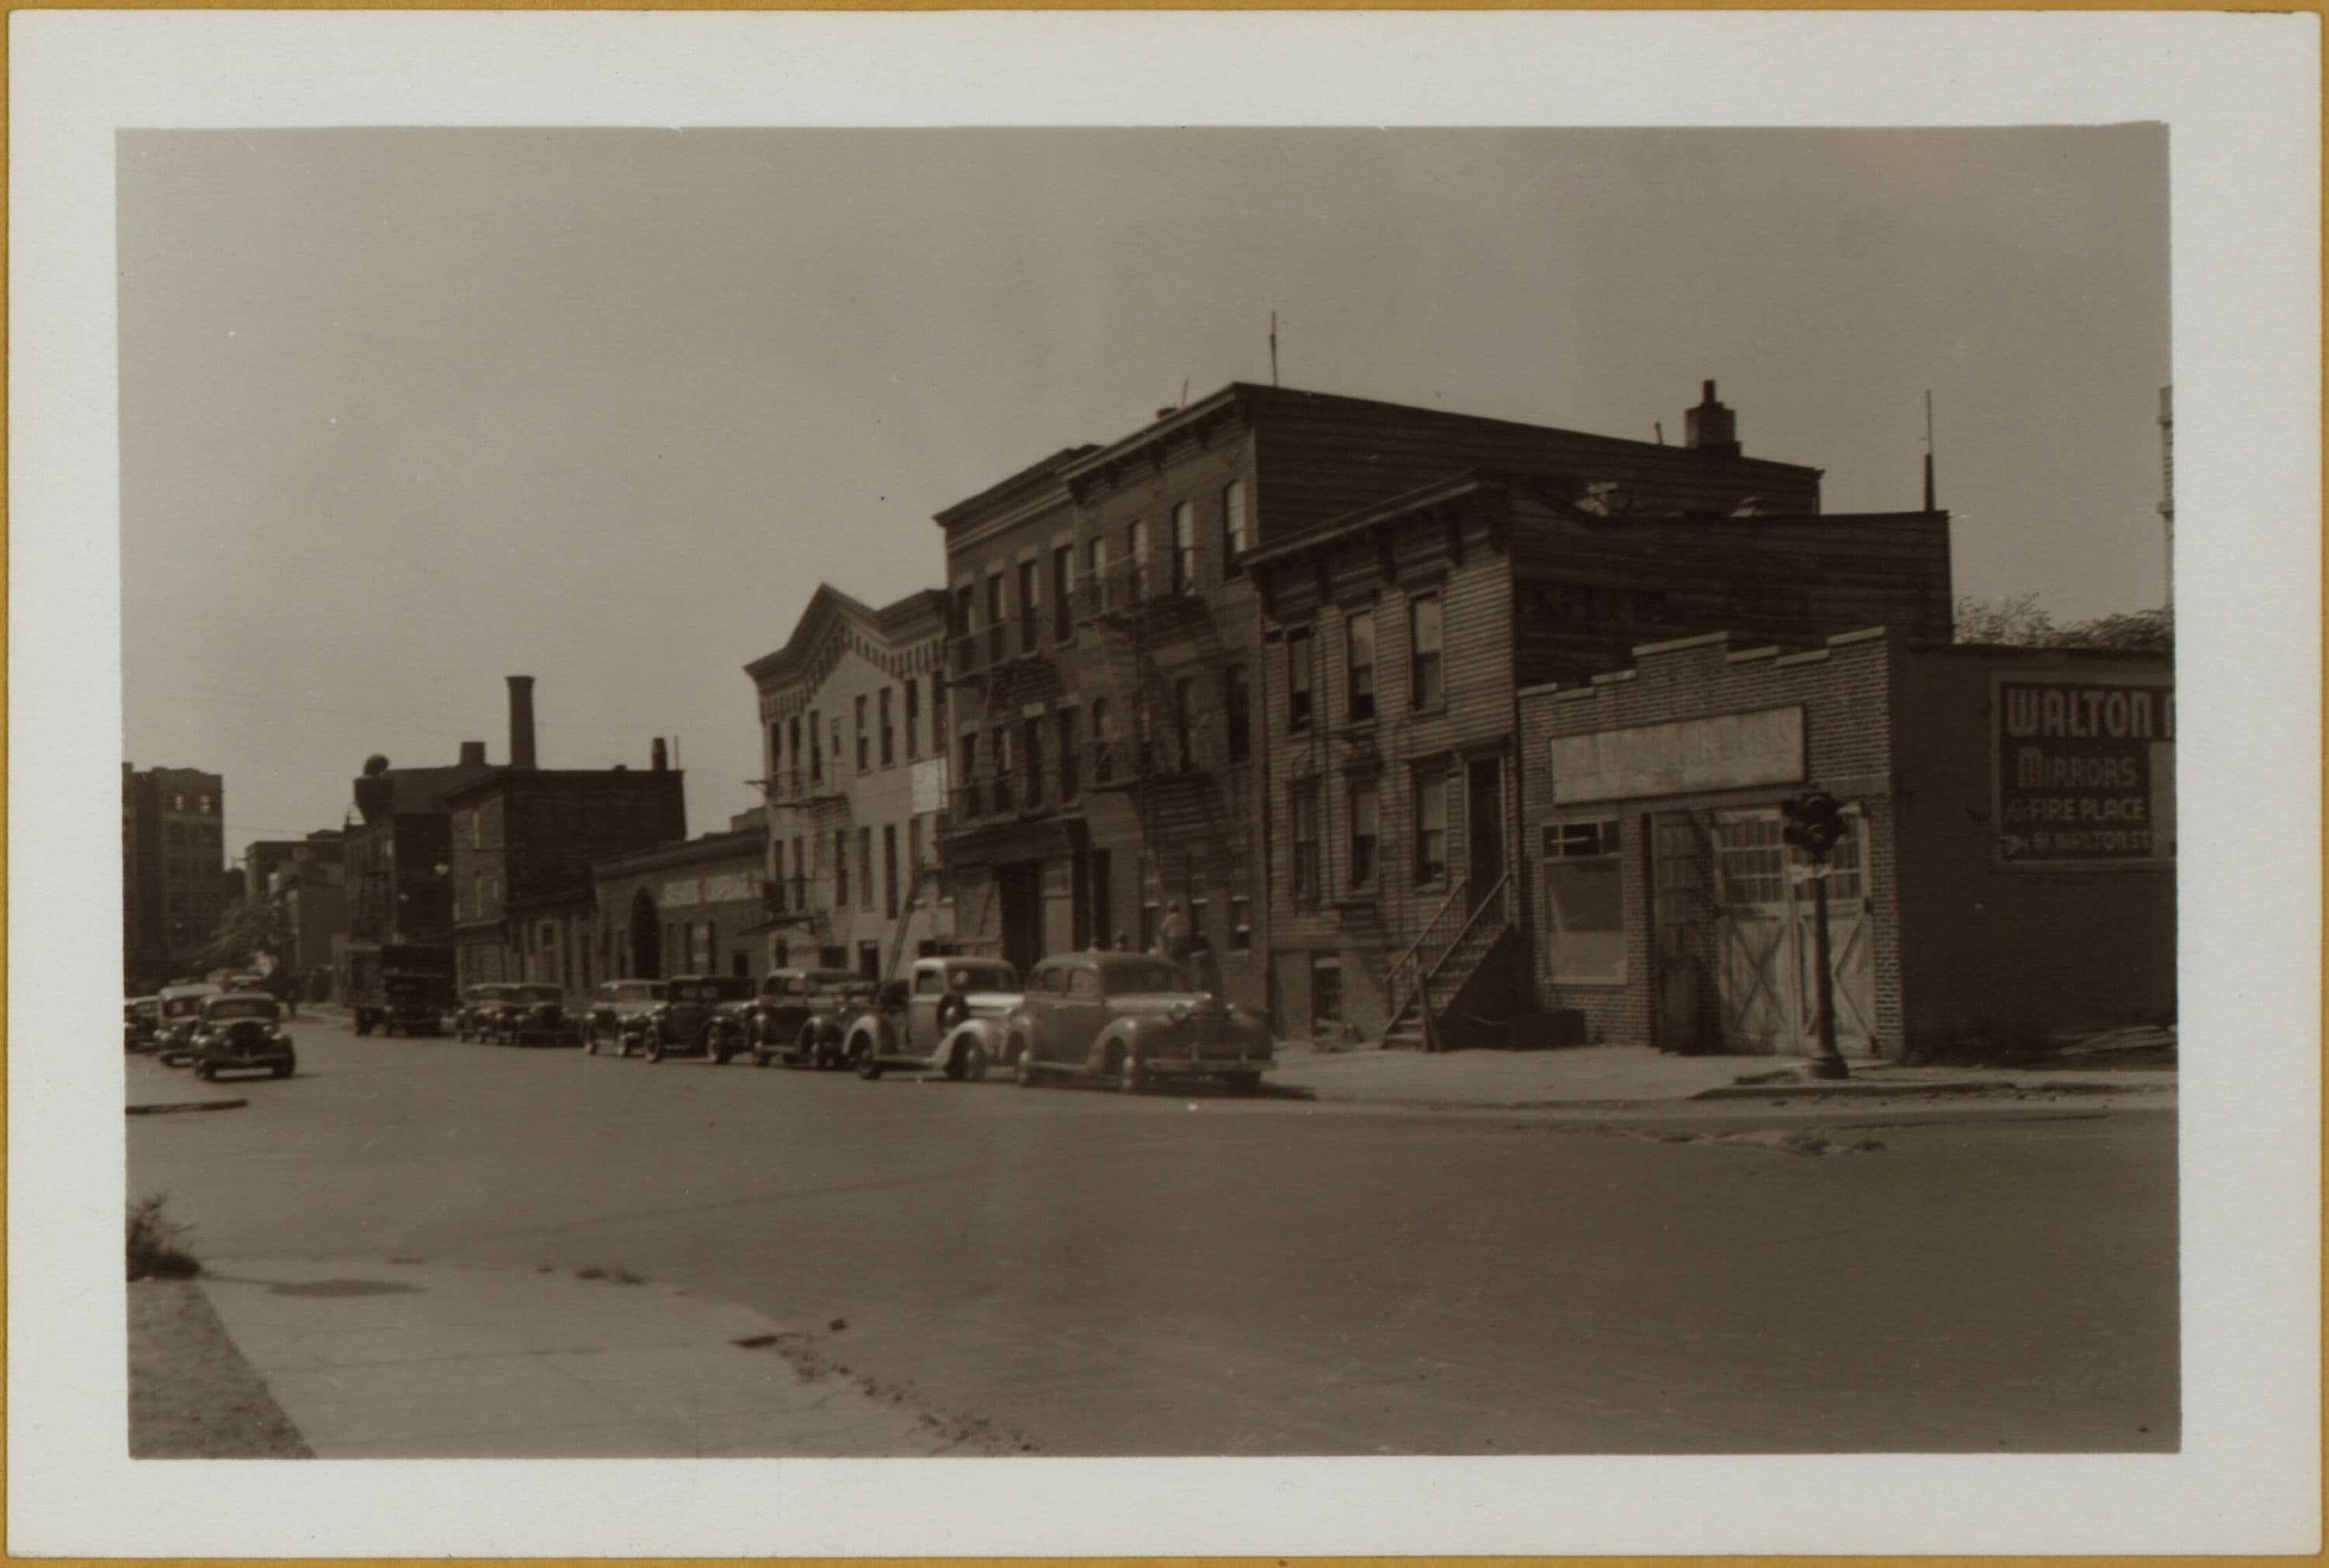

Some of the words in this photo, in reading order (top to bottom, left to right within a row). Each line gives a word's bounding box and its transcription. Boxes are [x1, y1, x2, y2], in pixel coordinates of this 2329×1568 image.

[2007, 689, 2153, 738] WALTON
[2031, 798, 2075, 821] FIRE
[2081, 798, 2145, 821] PLACE
[2054, 830, 2127, 851] WALTON
